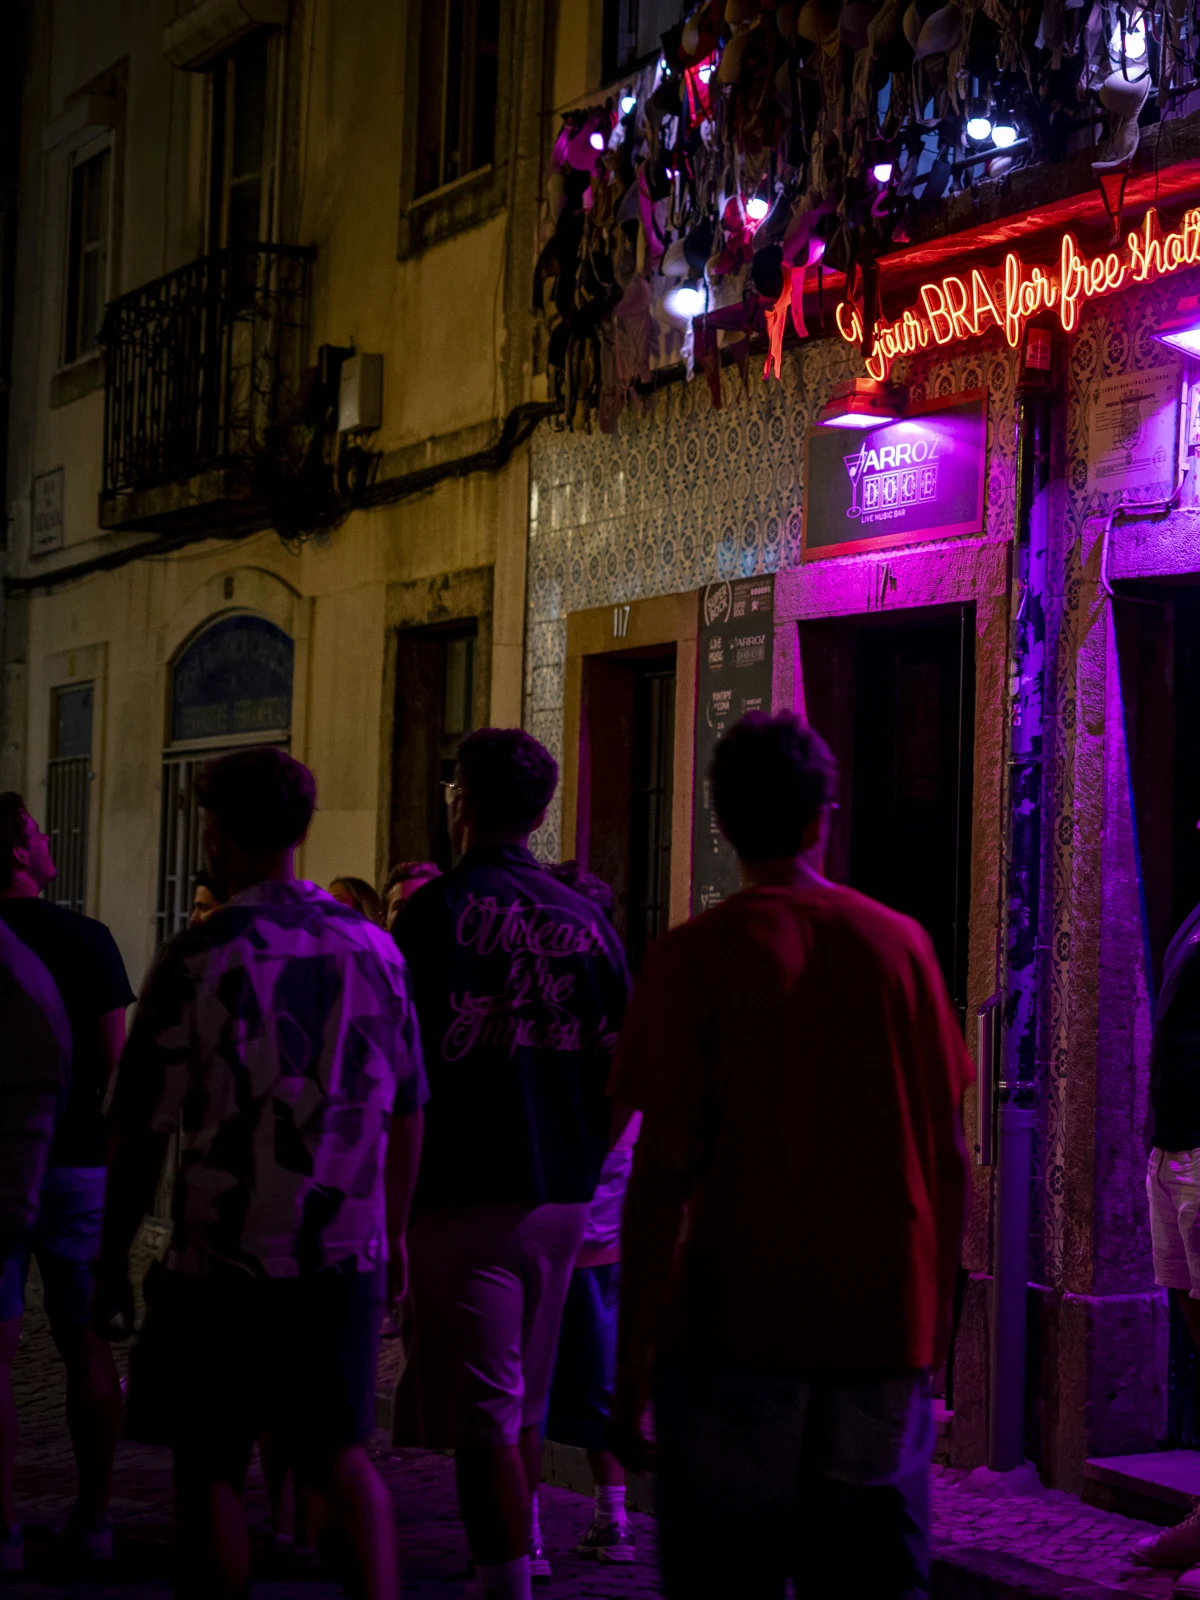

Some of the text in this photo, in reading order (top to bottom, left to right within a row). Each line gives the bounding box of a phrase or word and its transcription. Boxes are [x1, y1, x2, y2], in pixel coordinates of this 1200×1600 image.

[920, 269, 1003, 345] BRA
[1004, 252, 1058, 348] for
[1060, 233, 1127, 332] free
[862, 438, 941, 474] ARROZ
[864, 466, 937, 511] DOCE
[860, 508, 907, 525] LIVE MUSIC BAR
[613, 605, 631, 639] 117
[736, 634, 766, 647] ARROZ
[736, 647, 765, 661] DOCE
